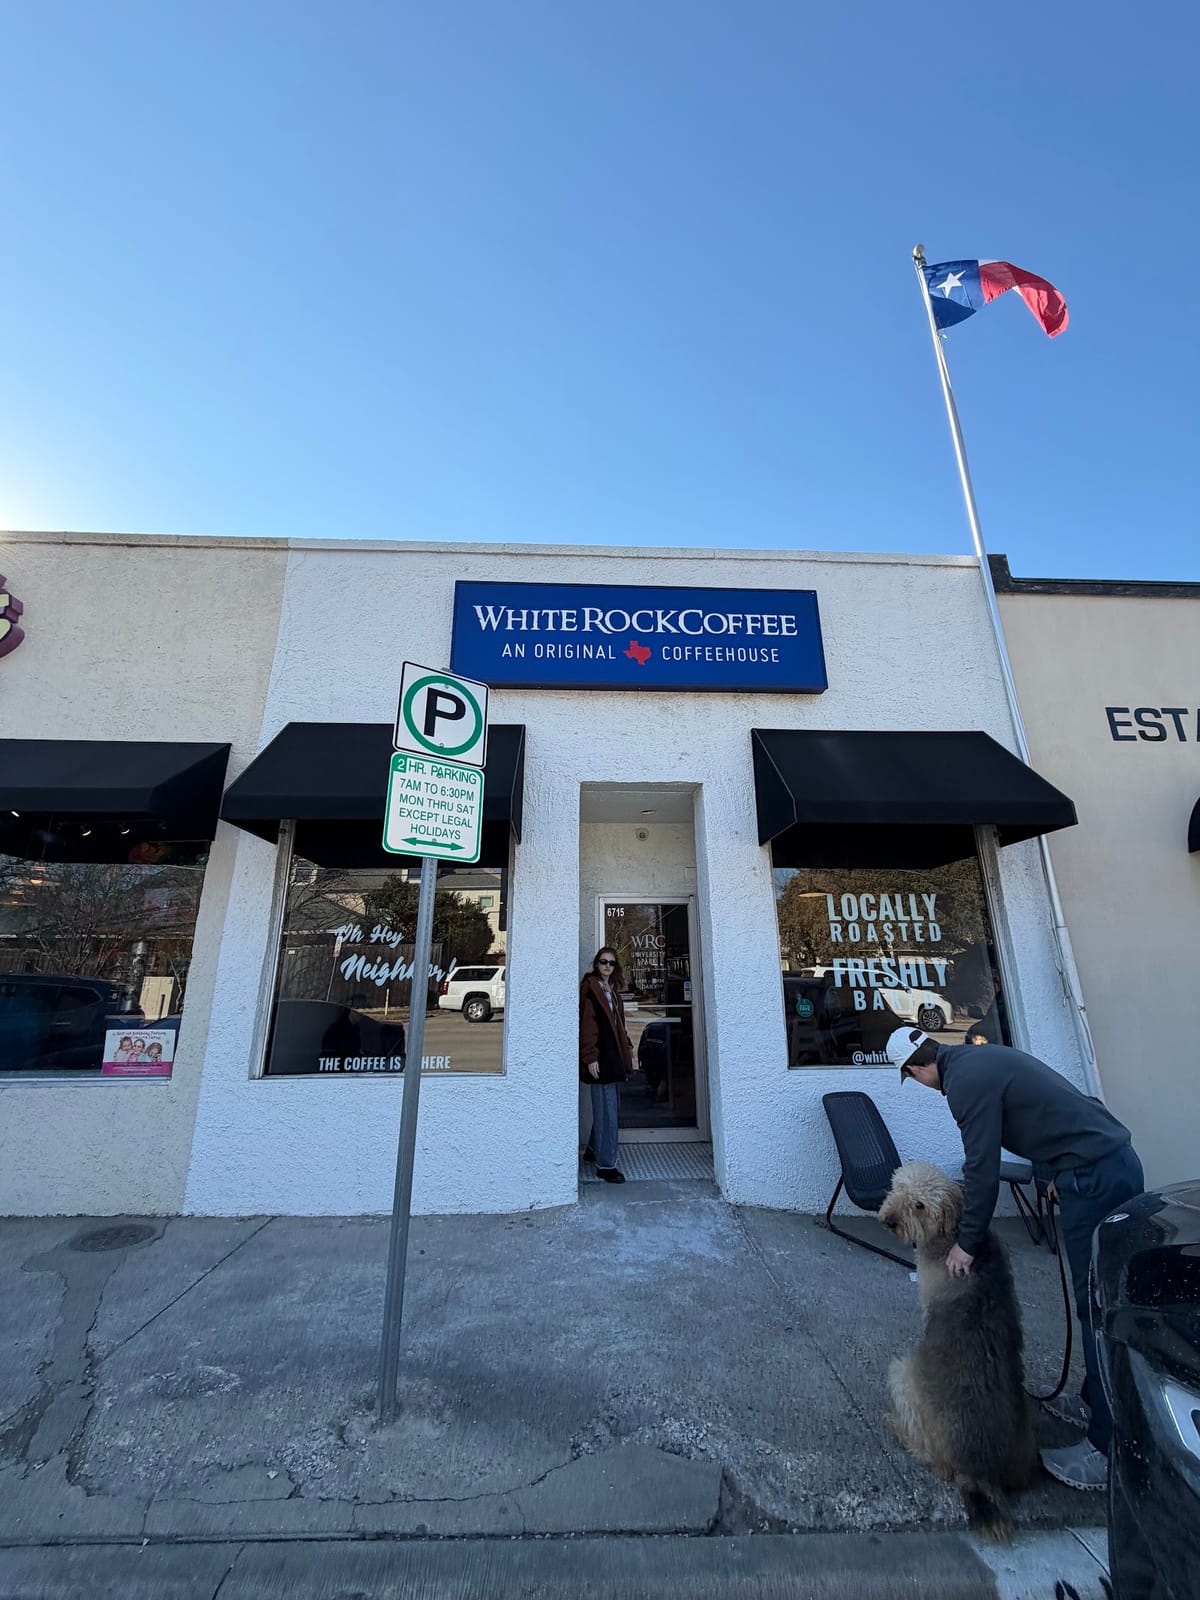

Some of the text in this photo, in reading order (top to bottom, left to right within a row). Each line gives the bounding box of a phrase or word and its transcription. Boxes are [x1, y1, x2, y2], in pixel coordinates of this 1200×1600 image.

[472, 605, 798, 636] WHITE ROCK COFFEE
[502, 643, 780, 662] AN ORIGINAL COFFEEHOUSE
[423, 687, 466, 737] P
[1105, 707, 1200, 742] EST
[397, 758, 477, 784] 2 HR. PARKING
[400, 778, 474, 801] 7AM TO 6:30PM
[399, 793, 475, 815] MON THRU SAT
[399, 808, 472, 828] EXCEPT LEGAL
[410, 824, 461, 840] HOLIDAYS
[607, 908, 625, 917] 6715
[826, 893, 937, 921] LOCALLY
[370, 924, 405, 948] Hey
[631, 934, 666, 949] WRC
[829, 922, 942, 942] ROASTED
[340, 953, 457, 987] Neighr!
[833, 957, 947, 988] FRESHLY
[319, 1055, 451, 1071] THE COFFEE IS HERE
[852, 1050, 890, 1065] @whit
